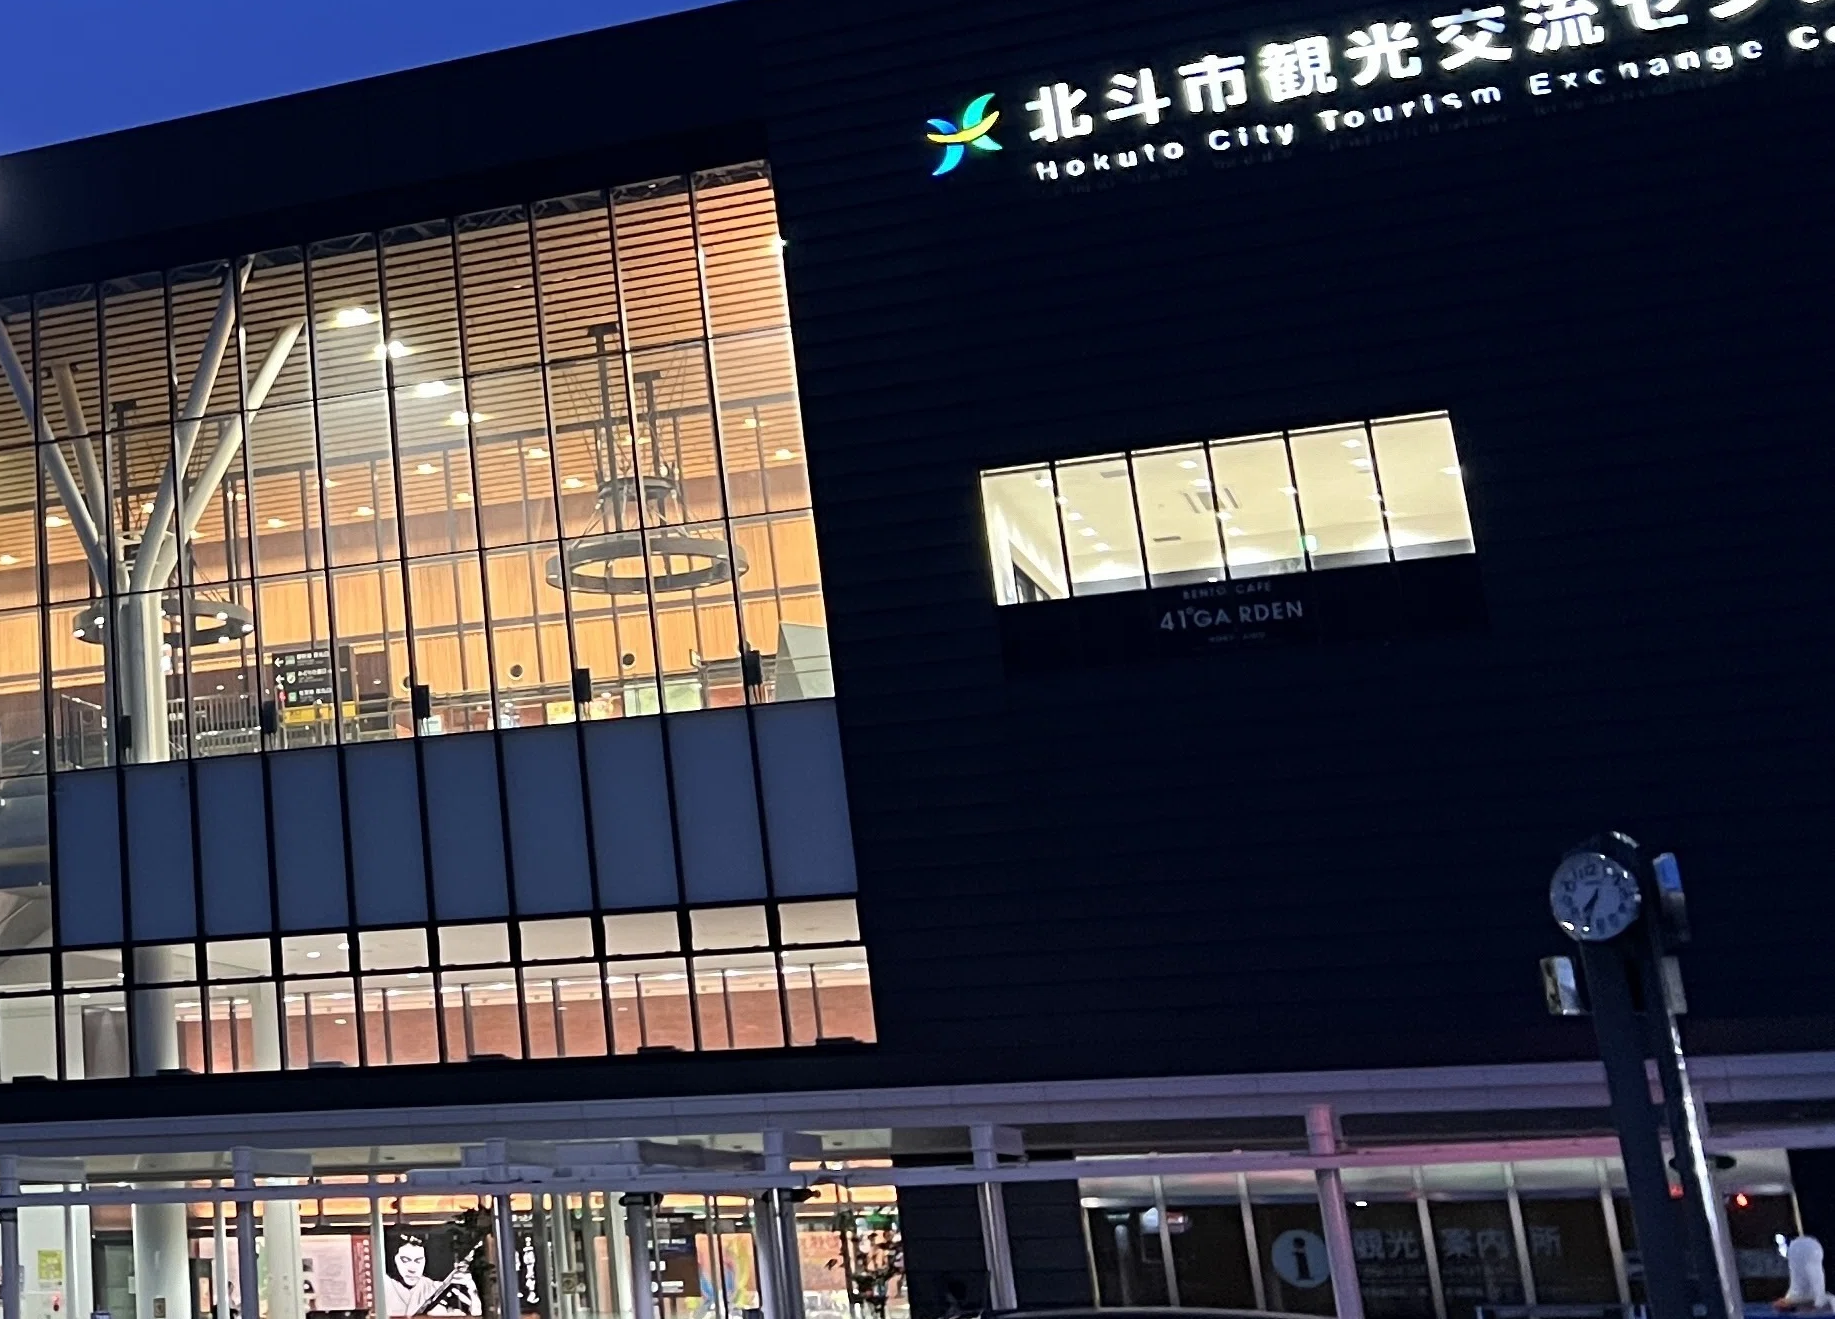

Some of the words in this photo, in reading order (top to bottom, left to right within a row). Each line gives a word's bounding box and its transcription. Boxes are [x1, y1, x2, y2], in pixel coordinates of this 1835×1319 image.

[1035, 141, 1184, 181] Hokuto
[1208, 122, 1294, 151] City
[1317, 86, 1501, 131] Tourism
